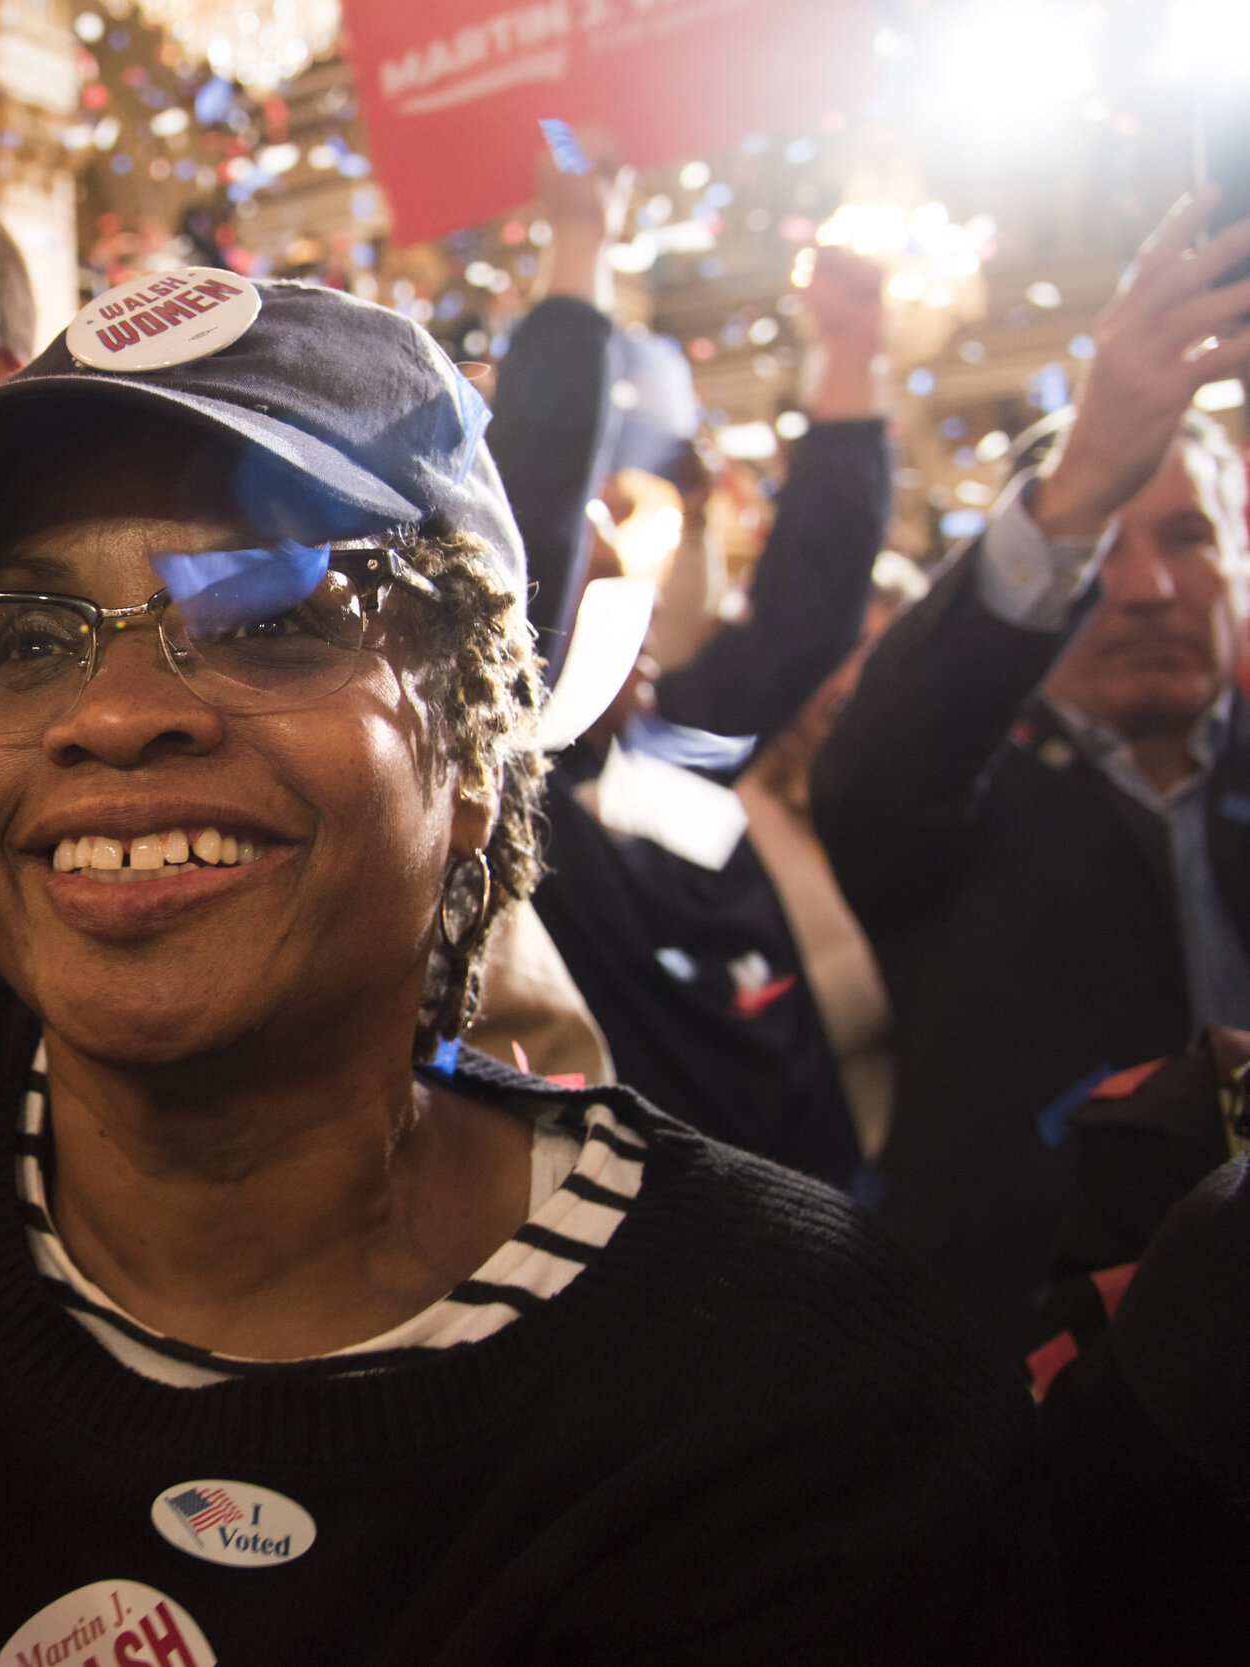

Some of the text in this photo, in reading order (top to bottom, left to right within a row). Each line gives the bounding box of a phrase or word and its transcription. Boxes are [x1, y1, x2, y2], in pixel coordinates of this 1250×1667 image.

[379, 2, 571, 99] MARTIN
[96, 279, 243, 353] WOMEN
[99, 277, 188, 320] WALSH
[219, 1525, 292, 1557] Voted
[251, 1503, 263, 1526] I
[15, 1590, 132, 1667] Martin J.
